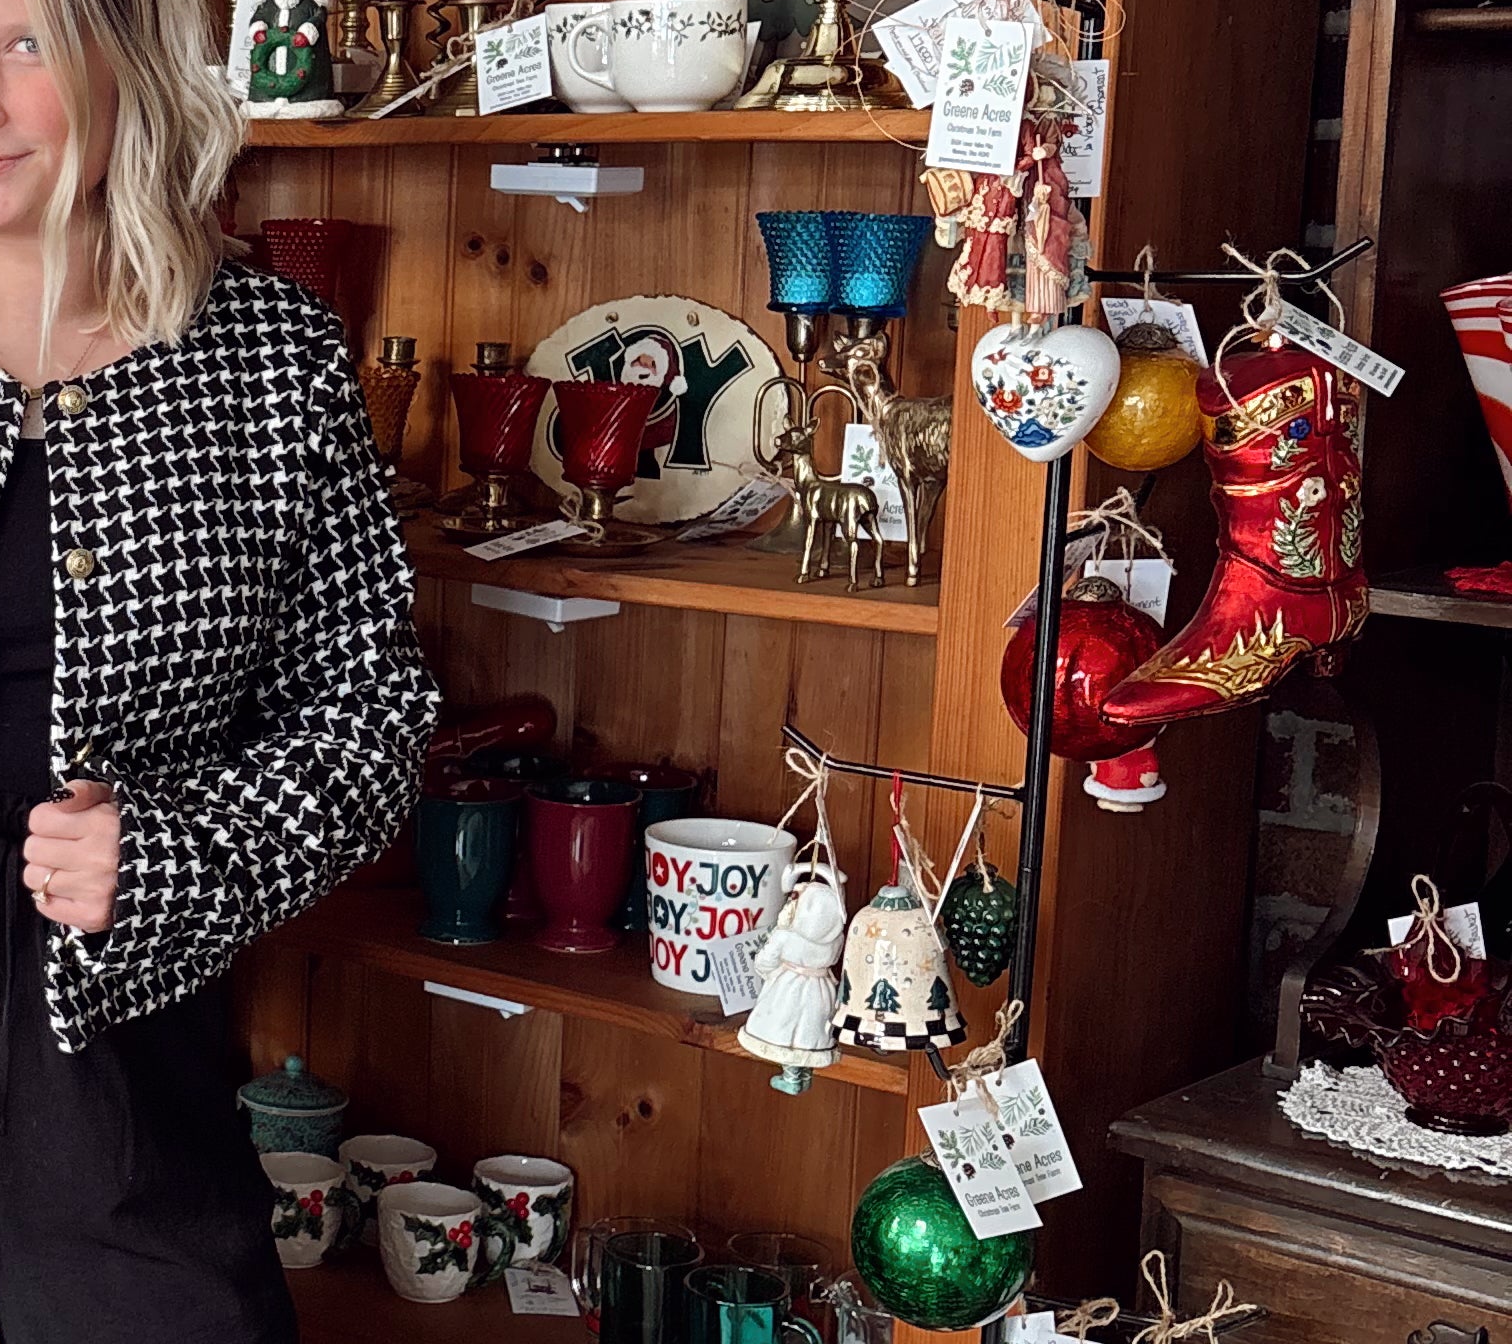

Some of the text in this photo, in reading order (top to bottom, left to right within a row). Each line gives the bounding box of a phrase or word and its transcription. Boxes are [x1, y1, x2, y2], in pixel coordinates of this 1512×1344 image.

[486, 61, 542, 84] Greene Acres
[943, 101, 1012, 123] Greene Acres
[883, 501, 903, 515] Acre
[696, 862, 769, 898] JOY
[696, 906, 764, 940] JOY
[735, 943, 749, 973] Greene
[1034, 1150, 1063, 1169] Acres
[965, 1186, 1020, 1207] Greene Acres
